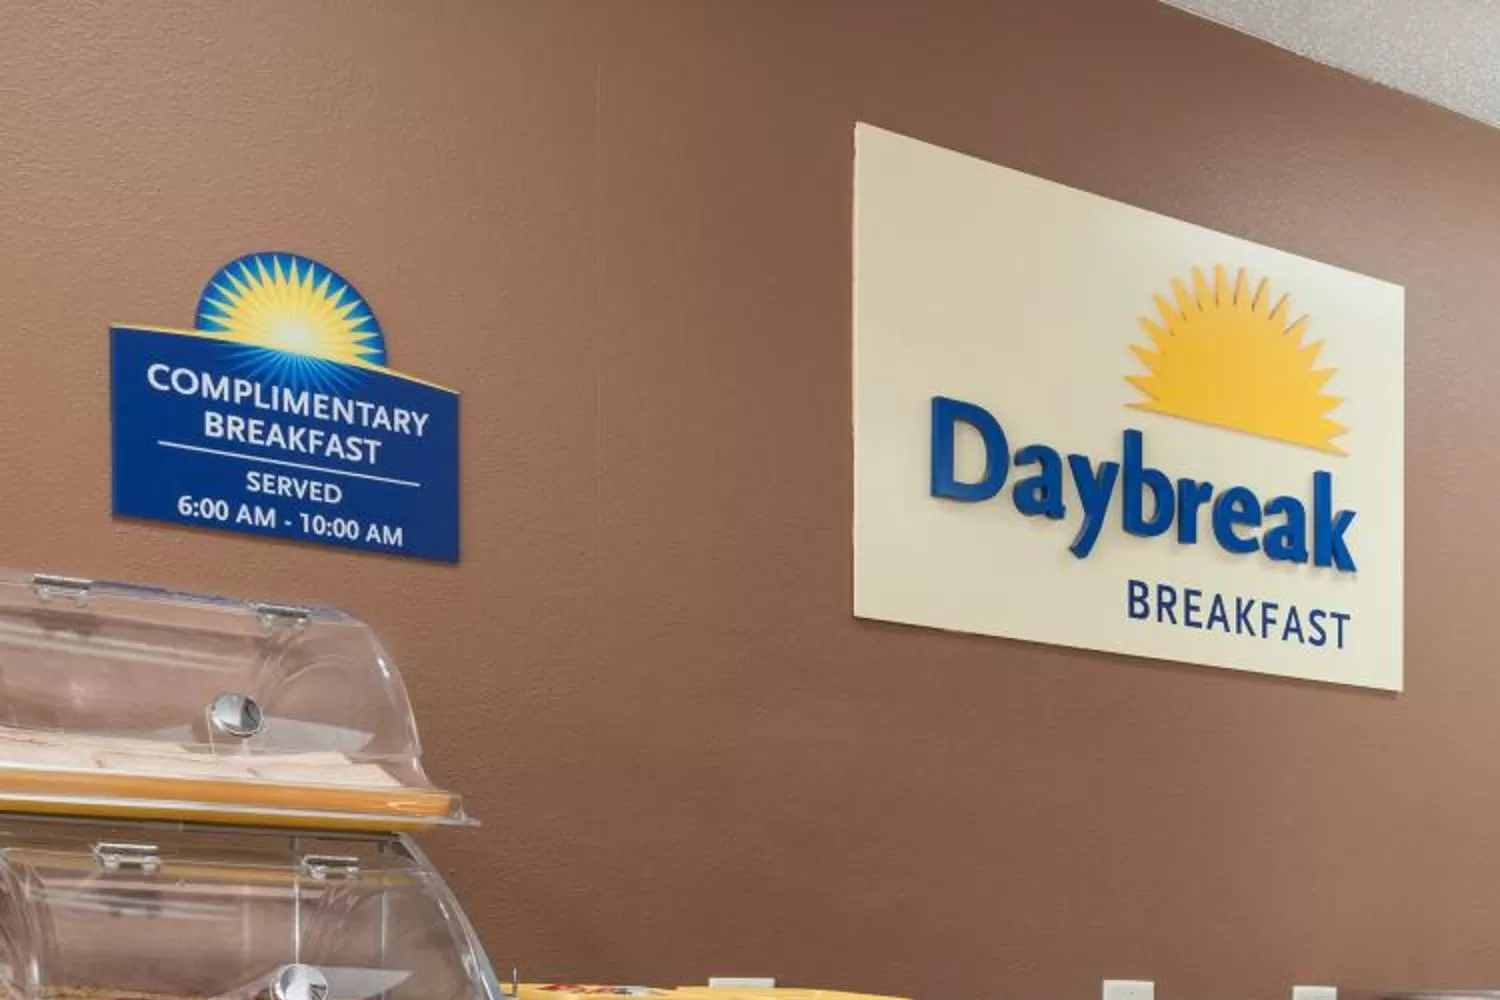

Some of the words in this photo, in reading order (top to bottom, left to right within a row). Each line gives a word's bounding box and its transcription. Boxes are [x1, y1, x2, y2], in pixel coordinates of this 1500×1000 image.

[147, 363, 429, 437] COMPLIMENTARY
[204, 411, 381, 464] BREAKFAST
[246, 471, 343, 504] SERVED
[930, 395, 1357, 573] Daybreak
[177, 495, 230, 521] 6:00
[235, 505, 277, 528] AM
[300, 513, 359, 541] 10:00
[365, 524, 404, 547] AM
[1127, 579, 1351, 649] BREAKFAST
